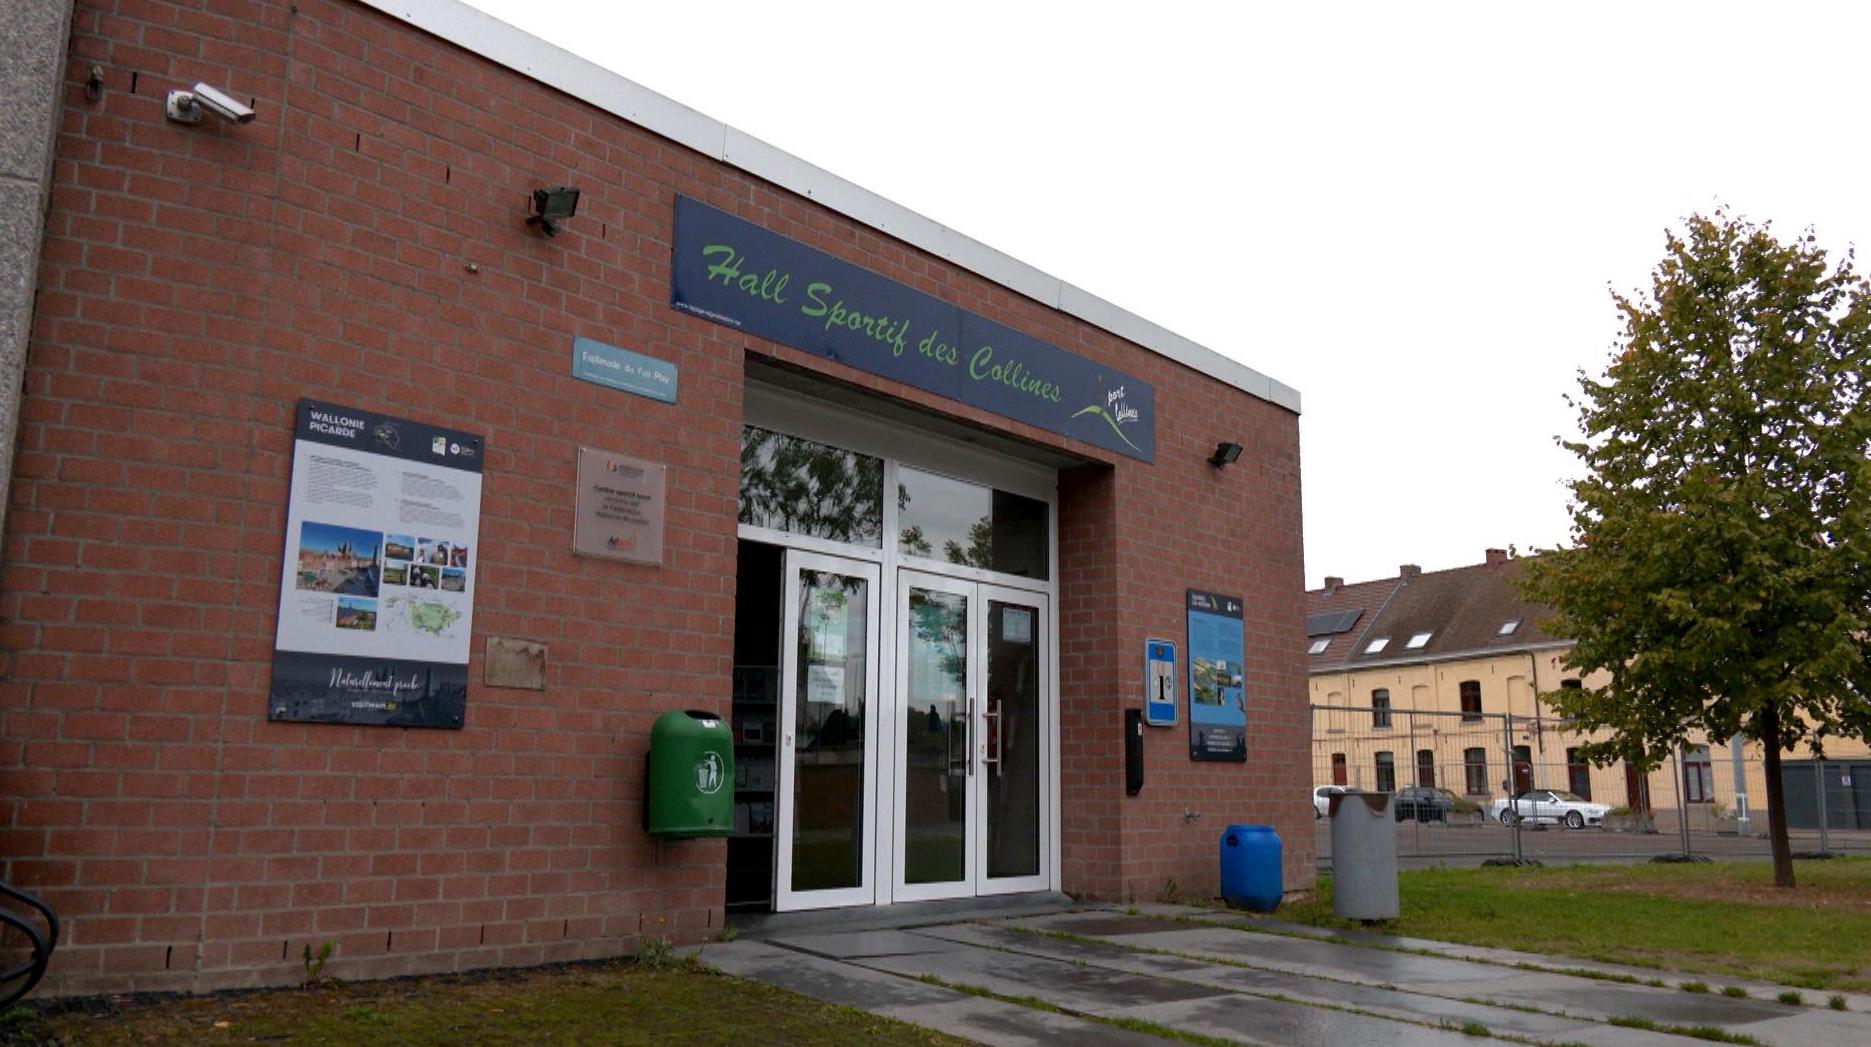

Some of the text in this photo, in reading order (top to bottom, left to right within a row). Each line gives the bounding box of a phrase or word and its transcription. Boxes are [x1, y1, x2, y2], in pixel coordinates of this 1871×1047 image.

[703, 244, 789, 304] Hall
[802, 282, 909, 357] Sportif
[919, 330, 958, 366] des
[969, 346, 1062, 402] Collines
[582, 351, 620, 370] Esplanade
[624, 363, 635, 374] du
[309, 420, 356, 439] PICARDE
[310, 410, 366, 430] WALLONIE
